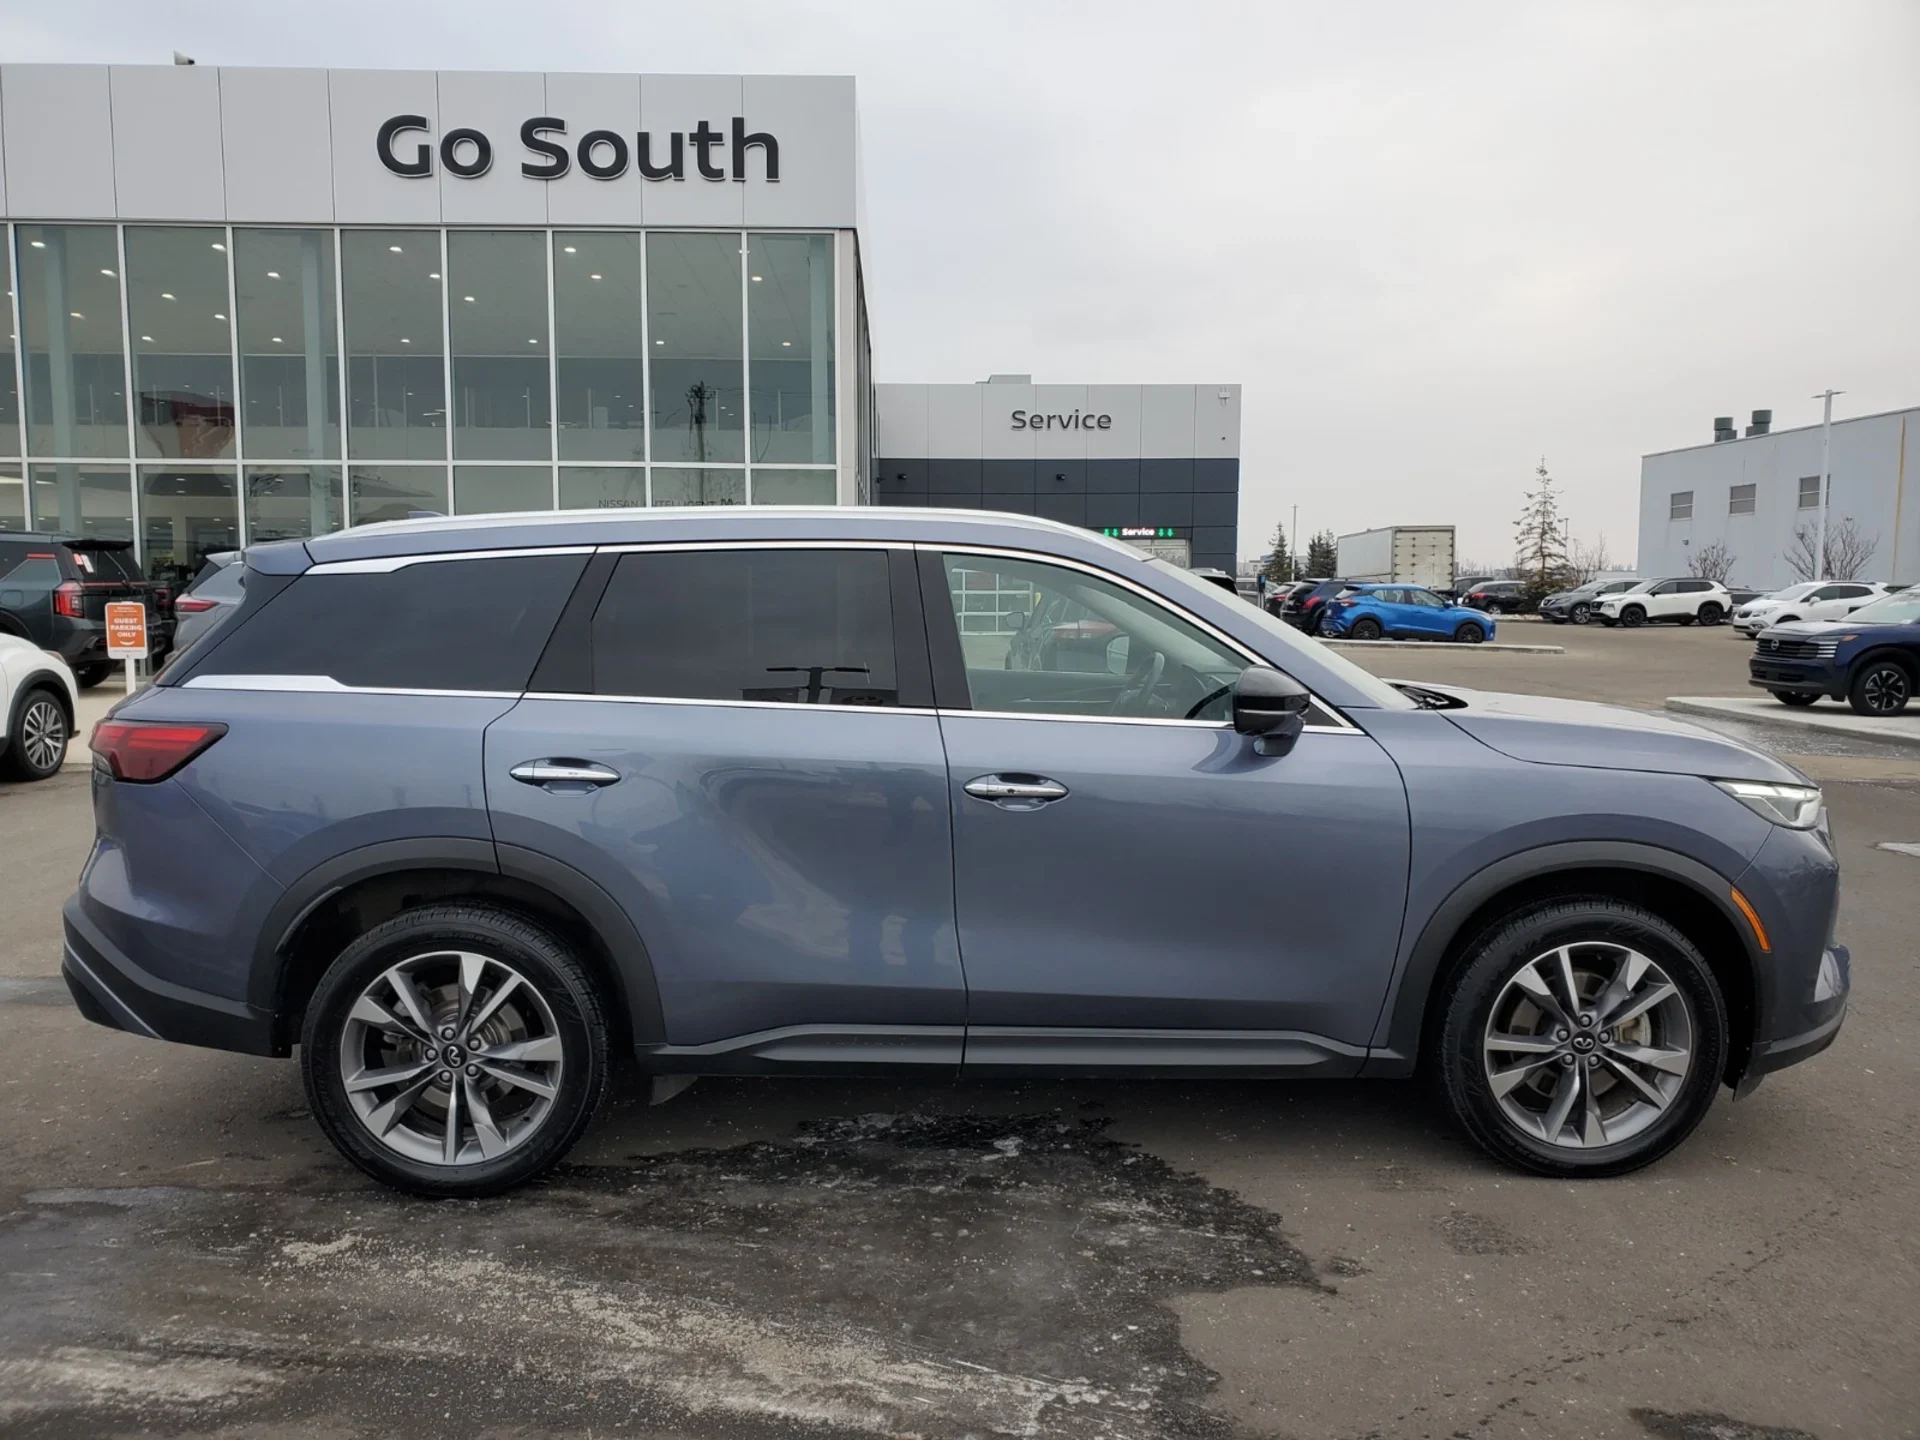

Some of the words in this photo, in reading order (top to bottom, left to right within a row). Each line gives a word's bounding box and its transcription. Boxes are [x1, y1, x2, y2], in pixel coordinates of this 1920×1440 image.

[376, 114, 493, 179] Go
[519, 116, 781, 182] South
[1011, 409, 1112, 431] Service
[598, 499, 638, 508] NISSAN
[1121, 527, 1155, 536] Service
